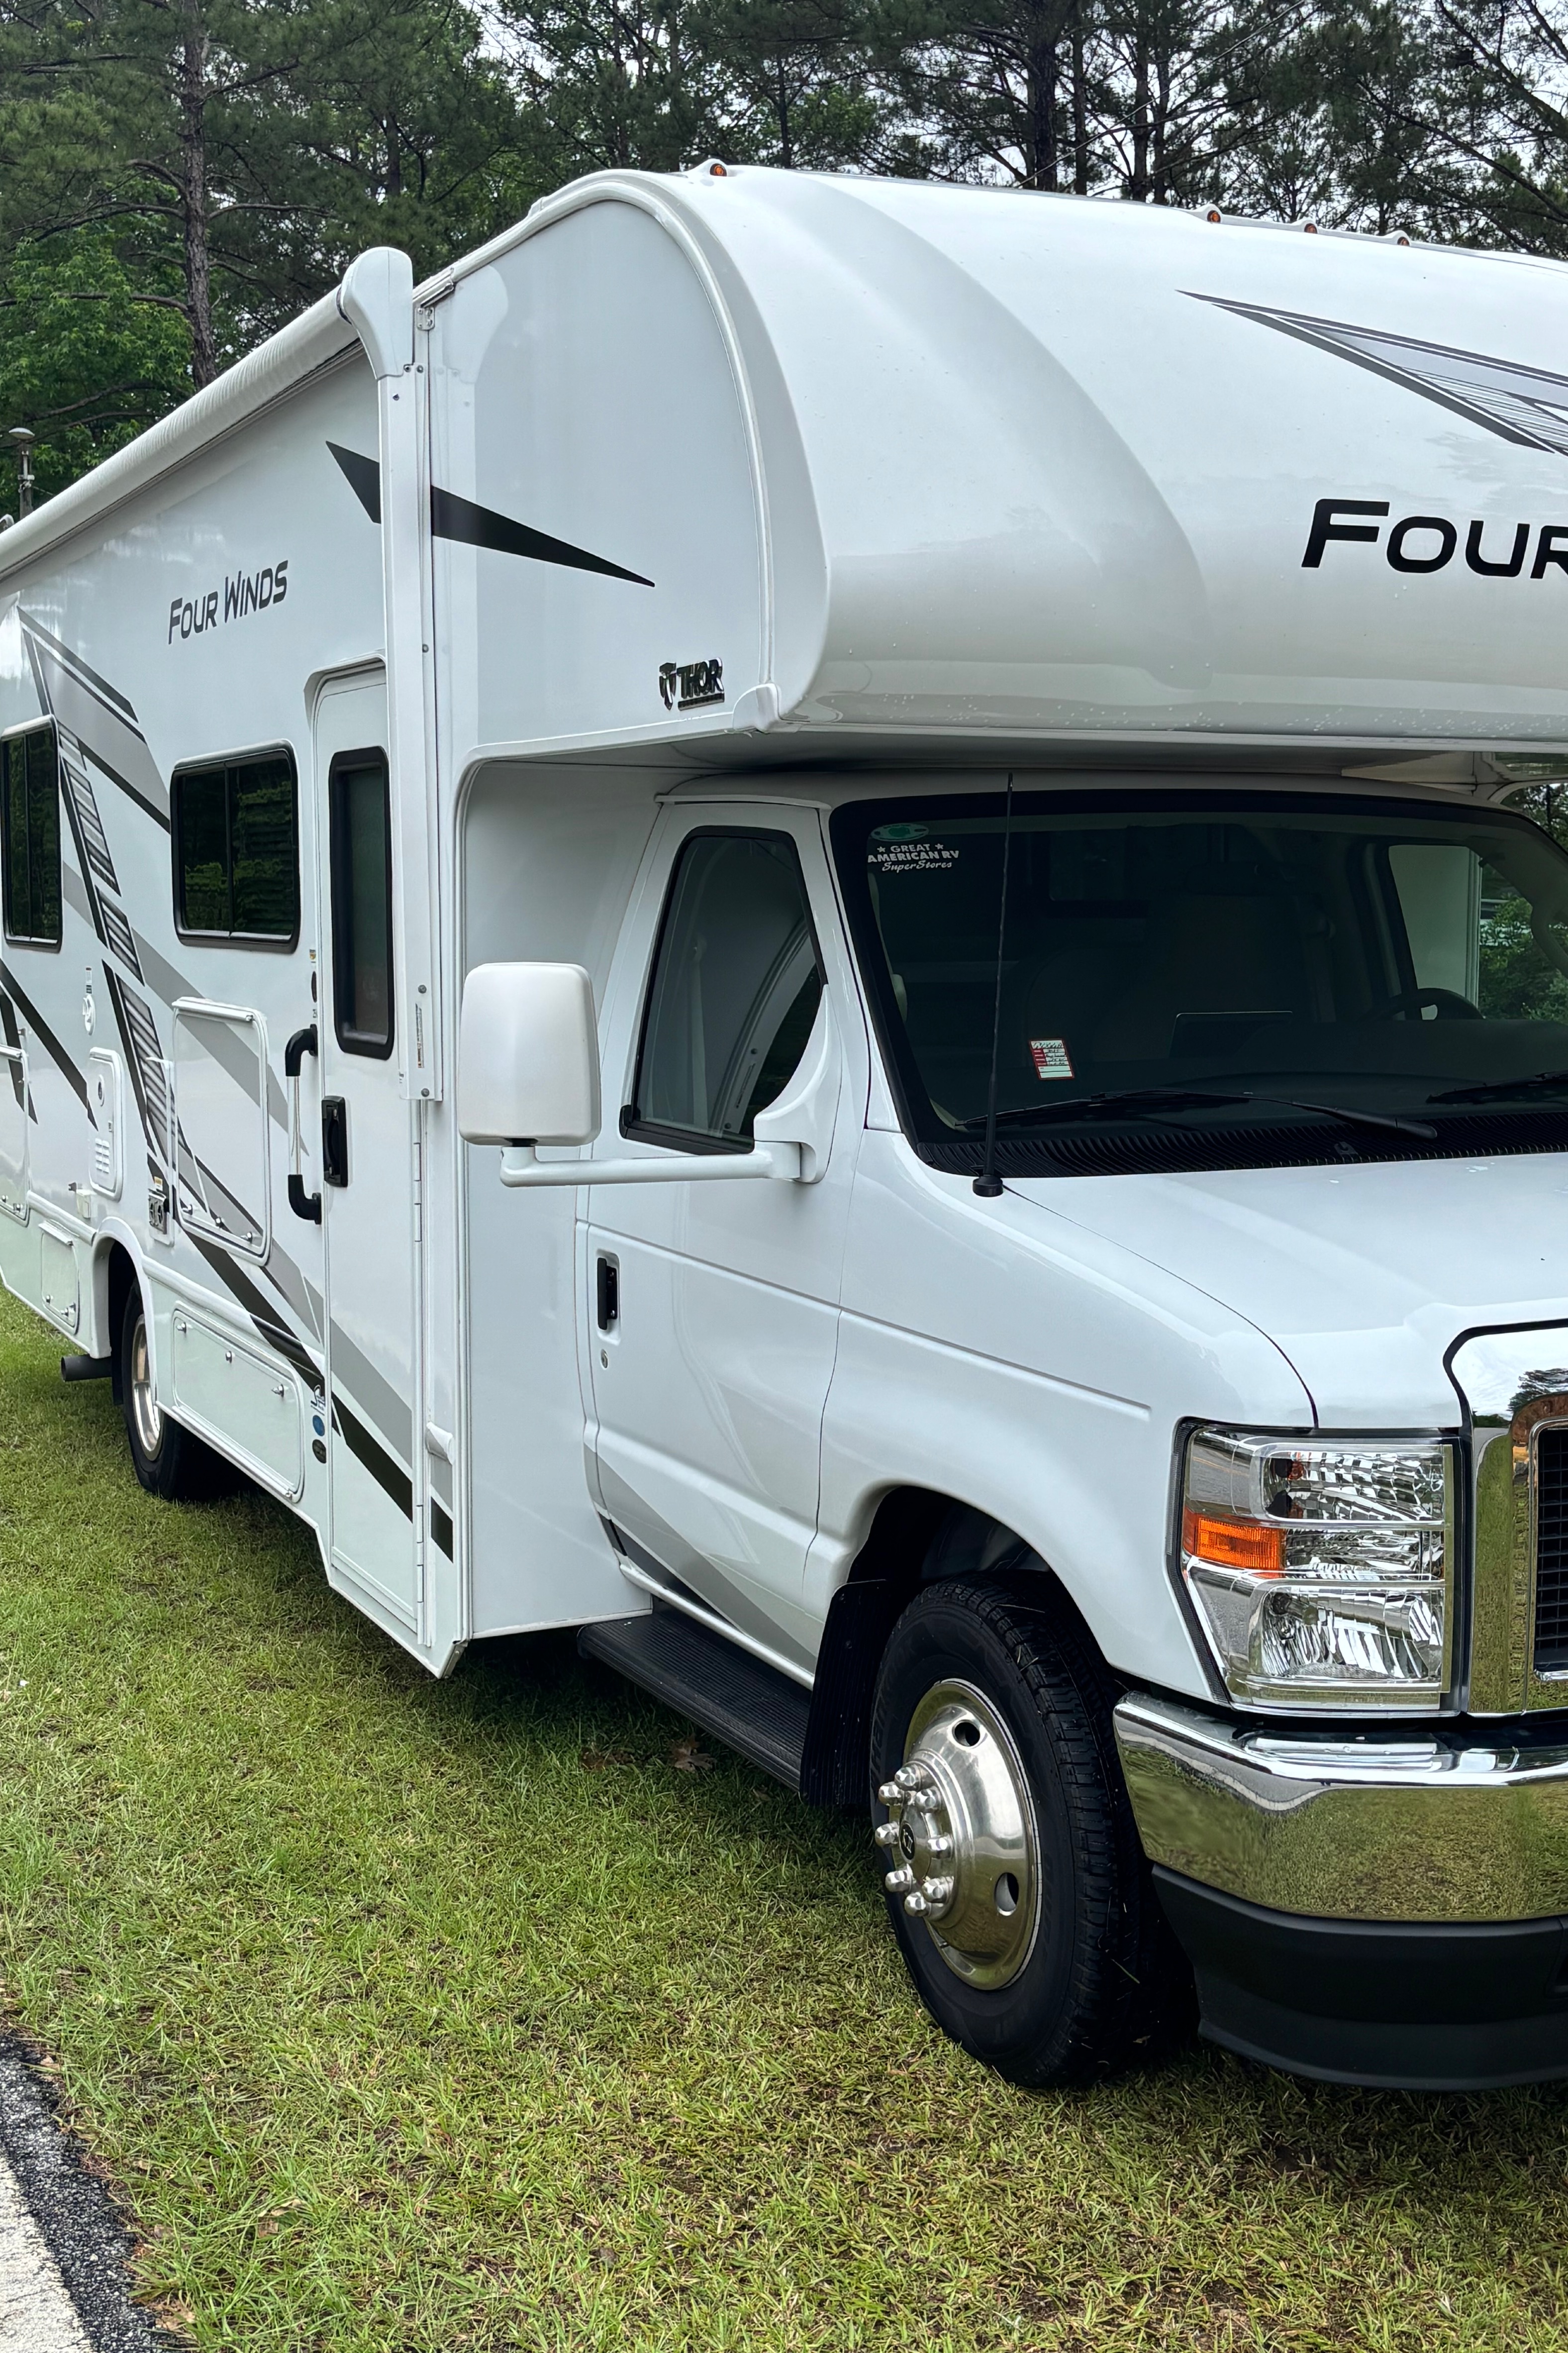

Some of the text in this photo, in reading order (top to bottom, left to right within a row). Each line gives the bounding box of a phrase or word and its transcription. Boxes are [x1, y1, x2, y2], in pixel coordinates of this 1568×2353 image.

[1301, 498, 1568, 579] FOUR
[168, 590, 218, 645] FOUR
[676, 657, 725, 699] THOR
[868, 851, 939, 863] AMERICAN
[890, 844, 930, 853] GREAT
